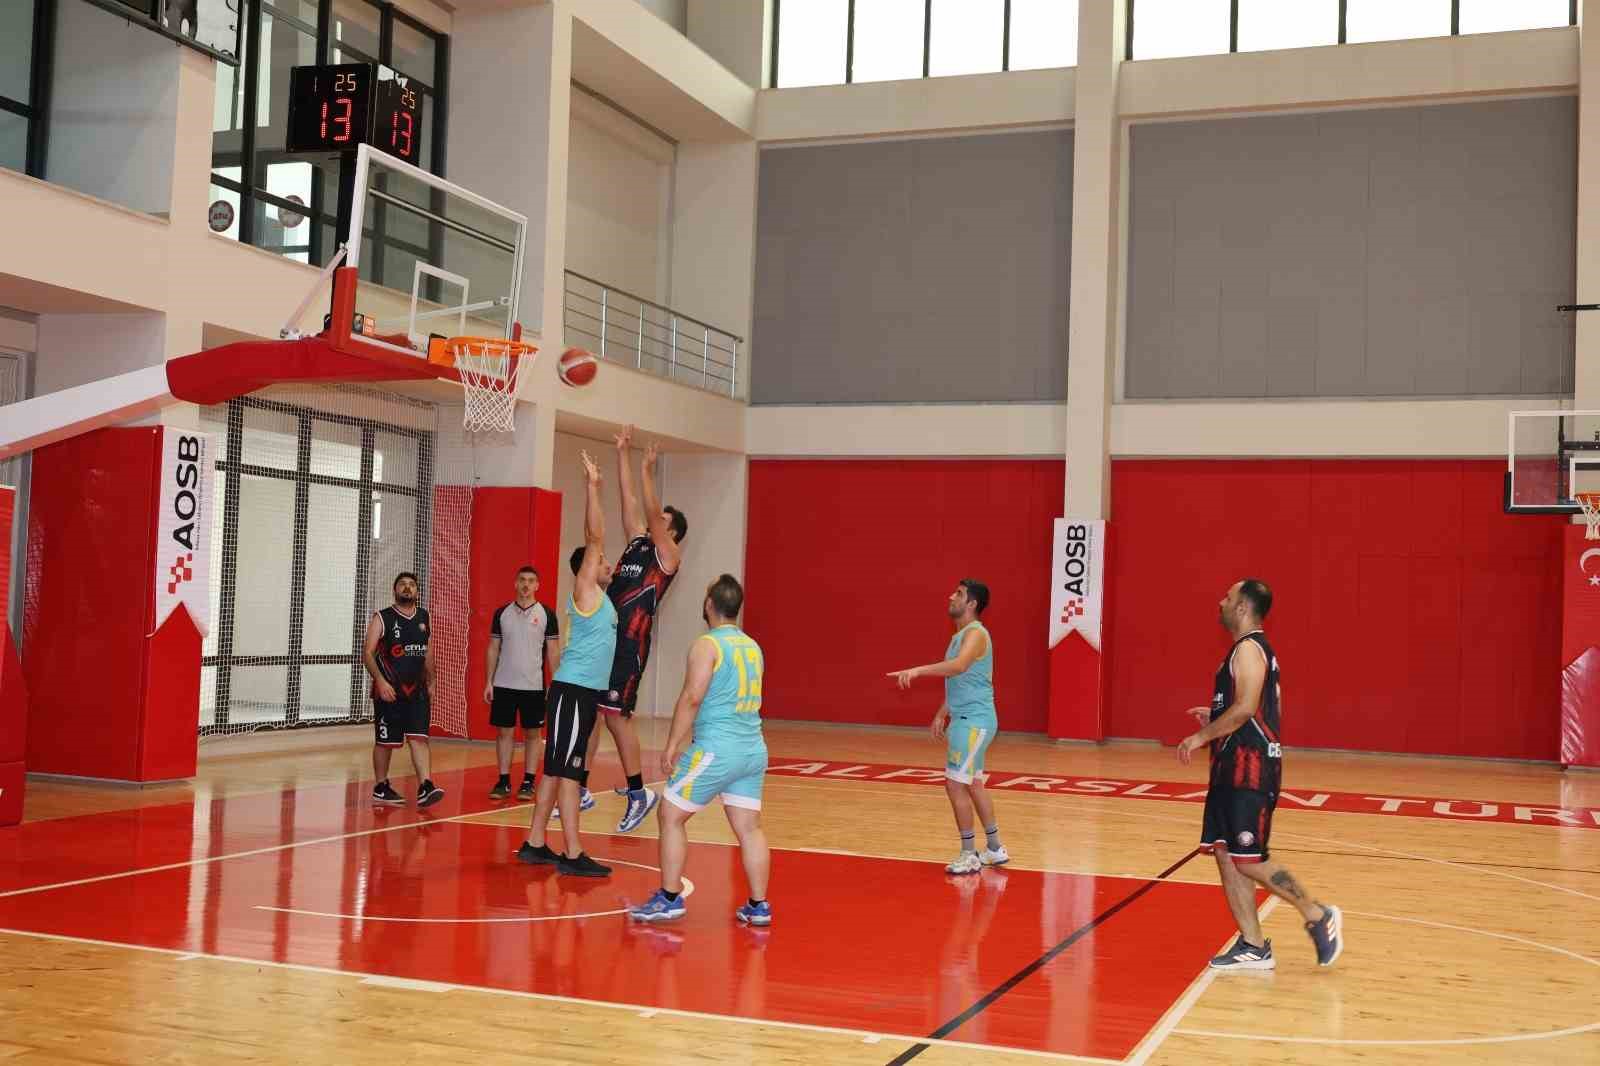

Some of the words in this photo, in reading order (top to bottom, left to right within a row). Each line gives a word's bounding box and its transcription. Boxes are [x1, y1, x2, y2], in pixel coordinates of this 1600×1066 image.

[335, 73, 357, 92] 25
[400, 87, 417, 110] 25
[321, 97, 353, 142] 13
[391, 111, 414, 157] 13
[172, 435, 200, 551] AOSB
[1063, 524, 1087, 597] AOSB
[394, 629, 402, 640] 3
[405, 643, 427, 652] CEYLA
[379, 725, 389, 740] 3
[768, 761, 1331, 807] ALPRSLN
